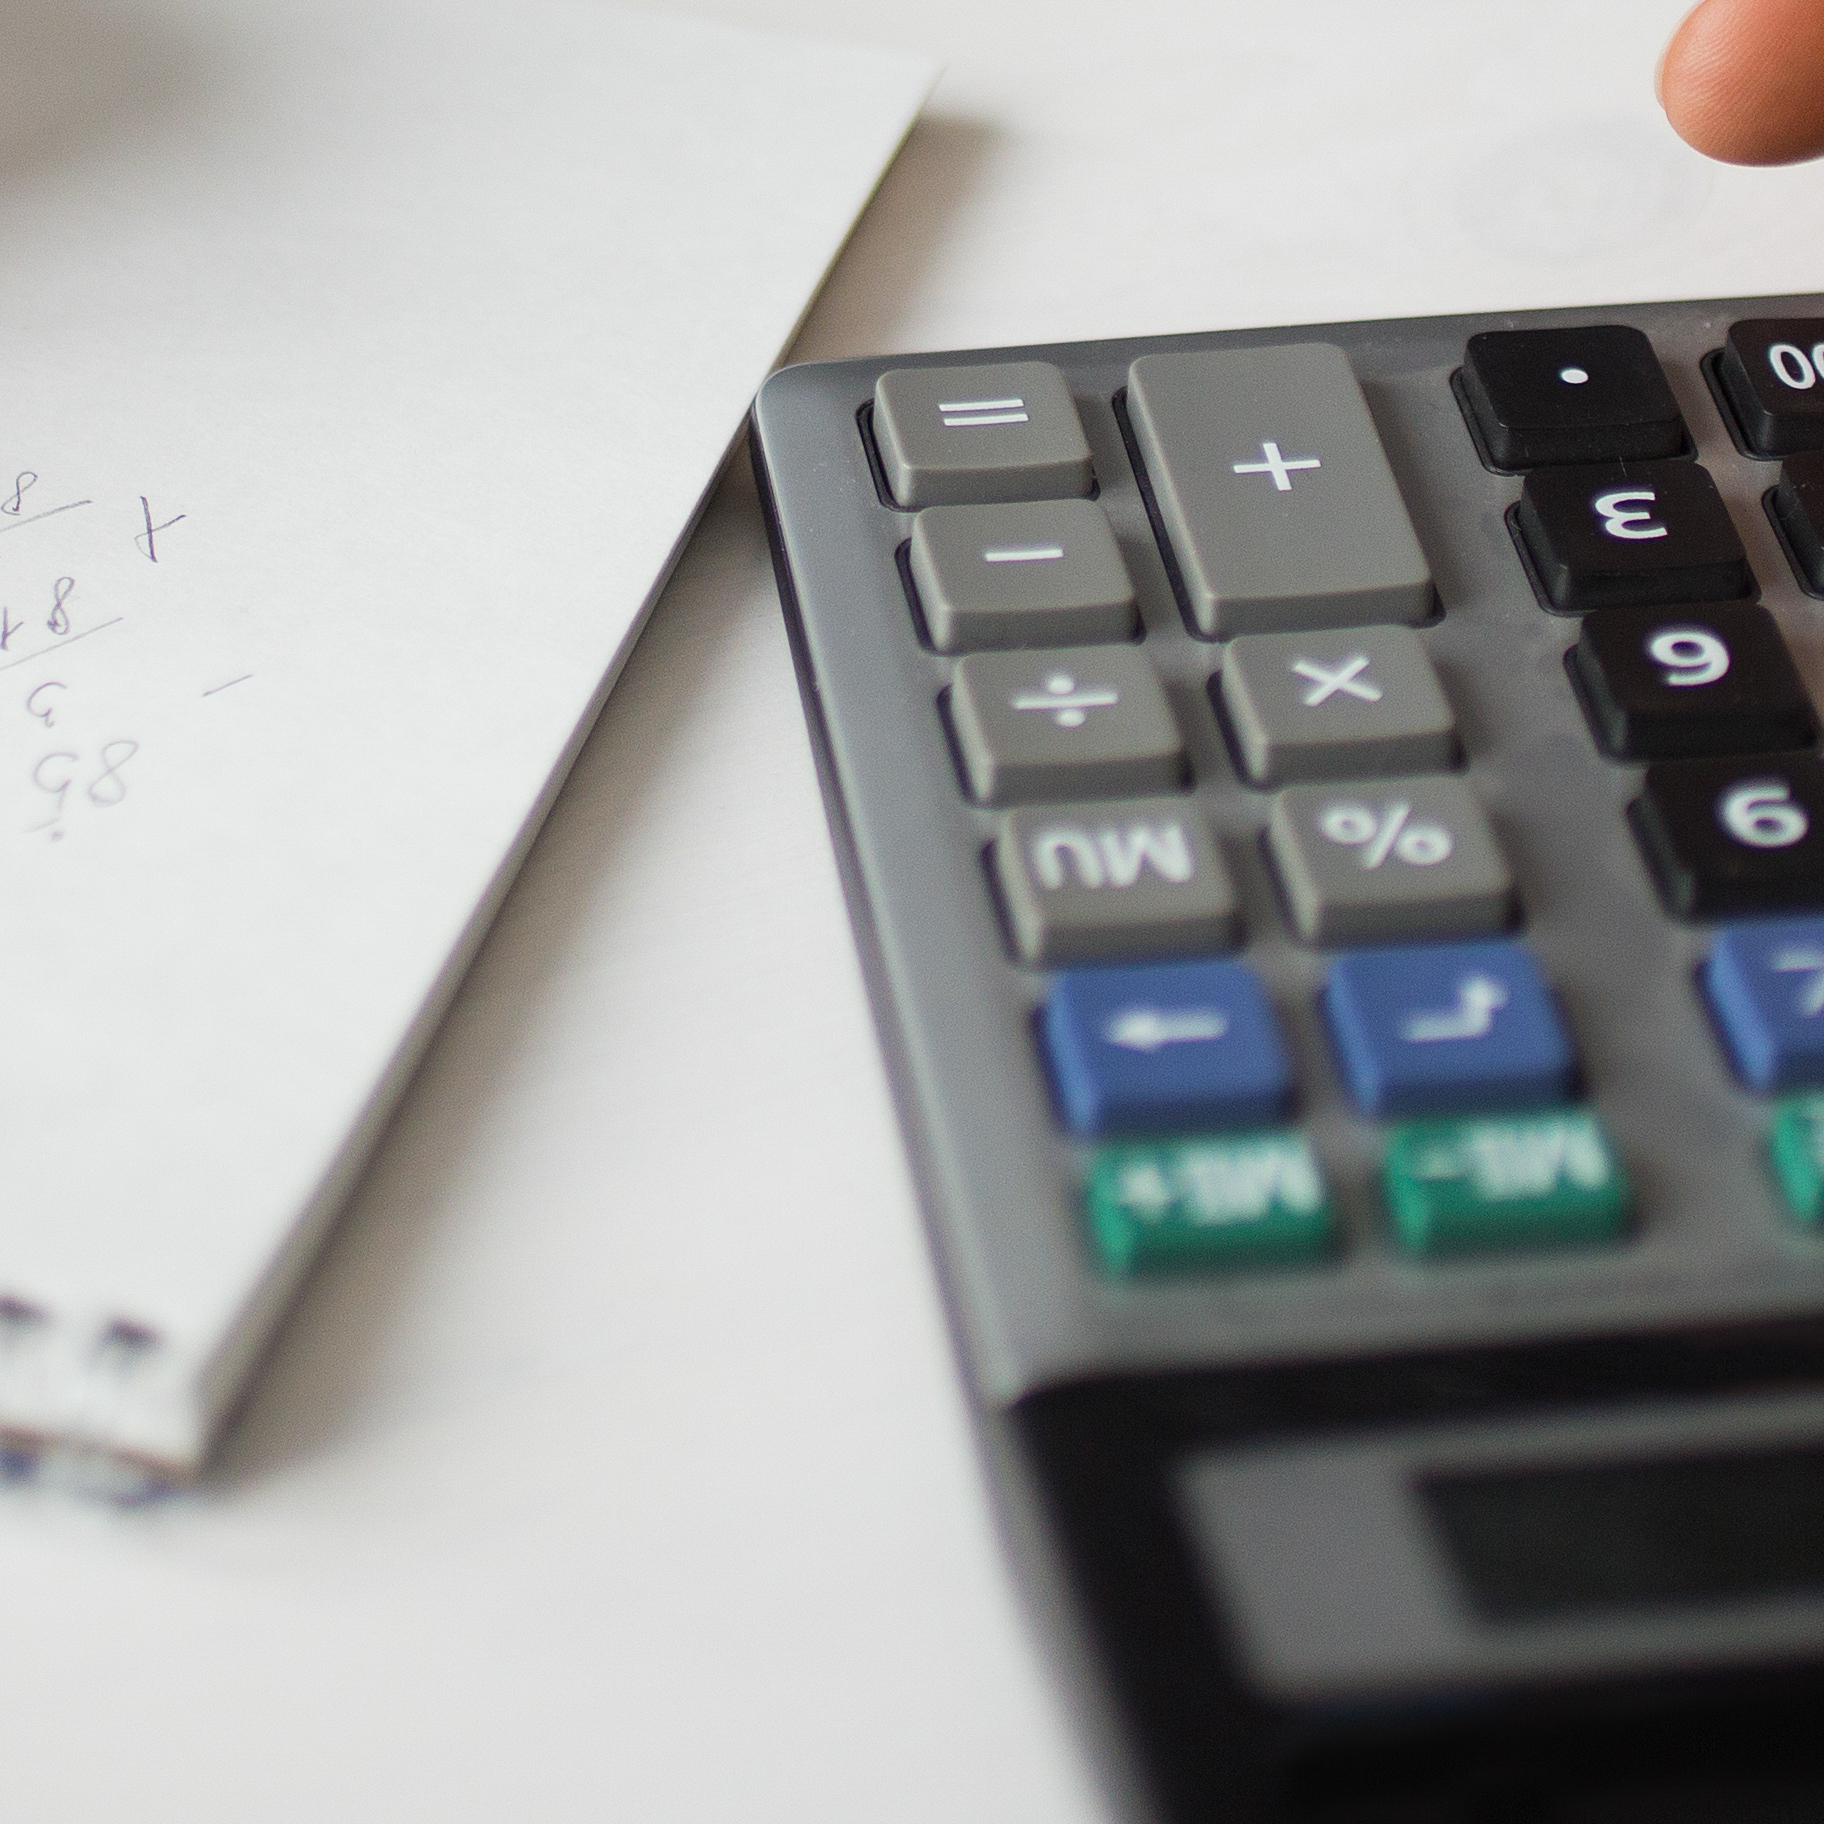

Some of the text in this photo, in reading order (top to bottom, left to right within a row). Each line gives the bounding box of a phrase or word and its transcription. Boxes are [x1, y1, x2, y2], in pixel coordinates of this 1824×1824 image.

[1594, 491, 1669, 540] 3
[1648, 630, 1730, 686] 6
[1719, 779, 1810, 849] 9
[1033, 824, 1193, 890] MU
